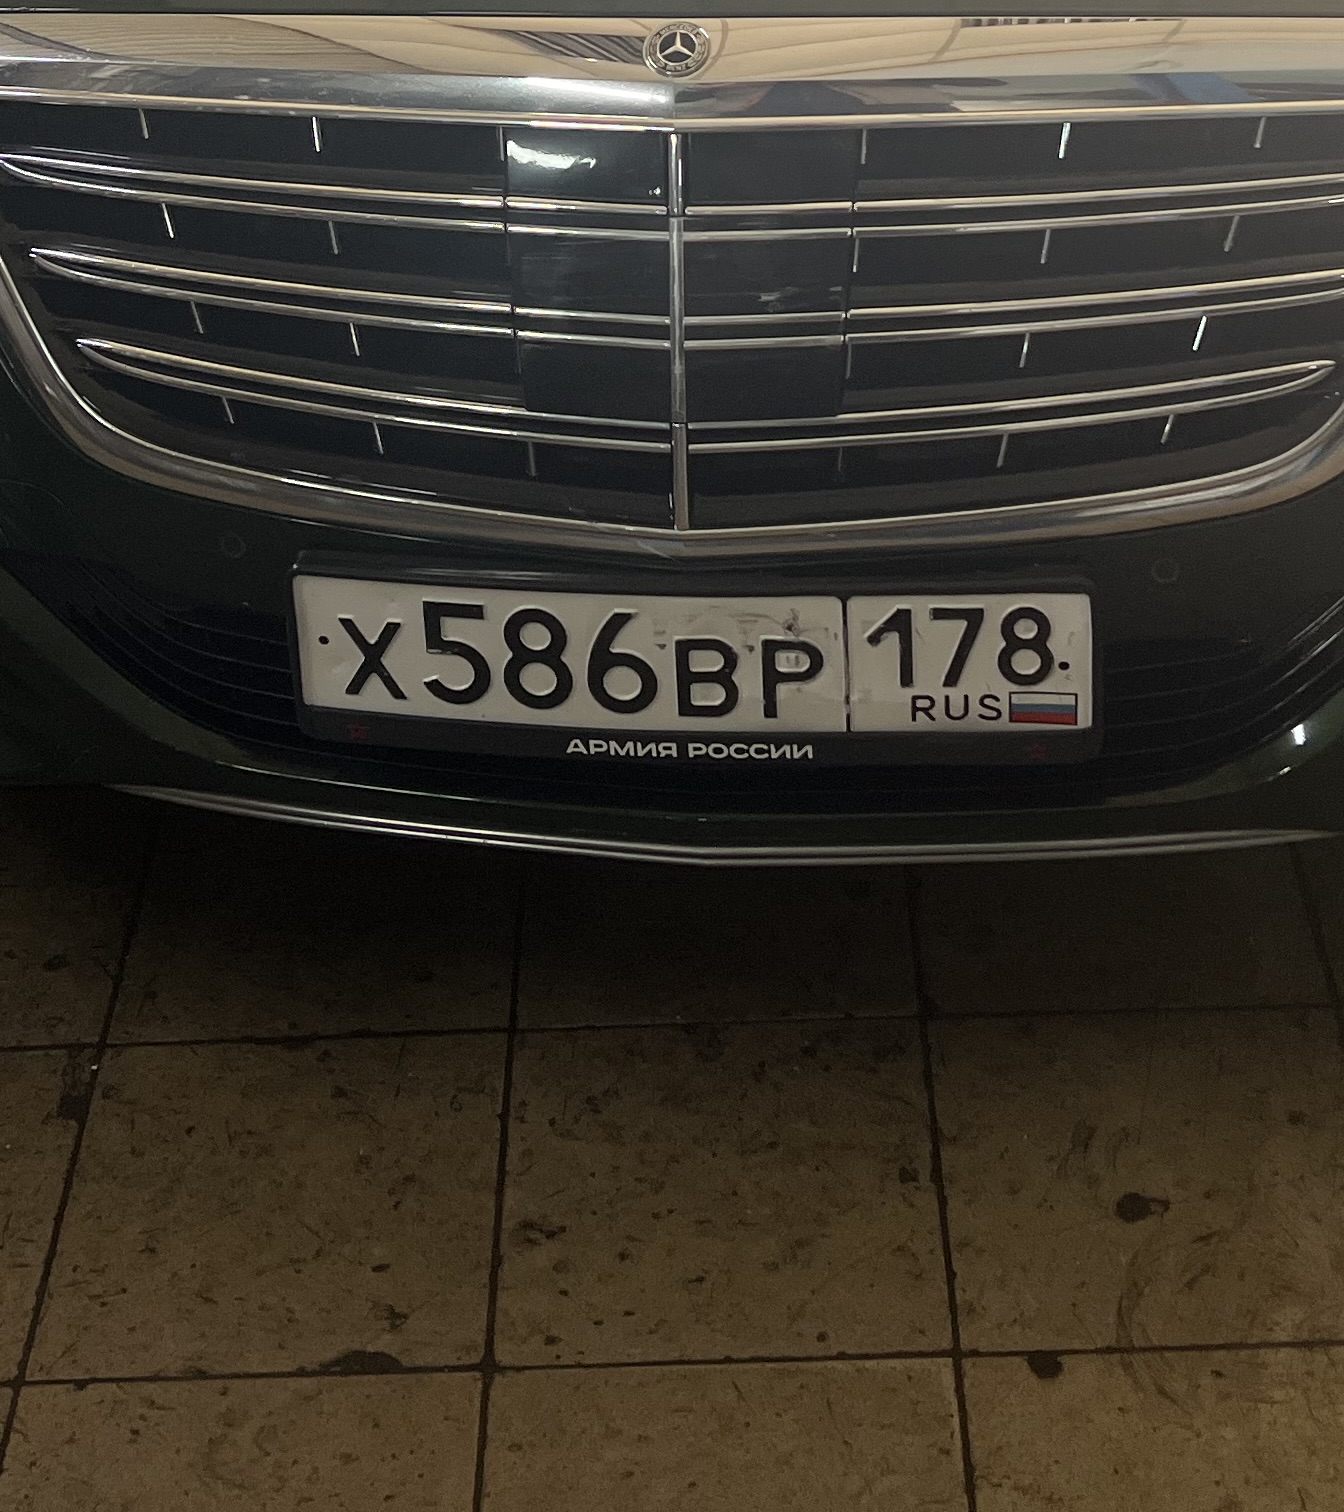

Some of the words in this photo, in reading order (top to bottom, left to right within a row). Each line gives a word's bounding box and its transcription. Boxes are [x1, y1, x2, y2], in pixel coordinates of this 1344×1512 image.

[865, 605, 1055, 688] 178
[911, 694, 1002, 722] RUS
[566, 739, 677, 758] АРМИЯ
[688, 742, 813, 759] РОССИИ
